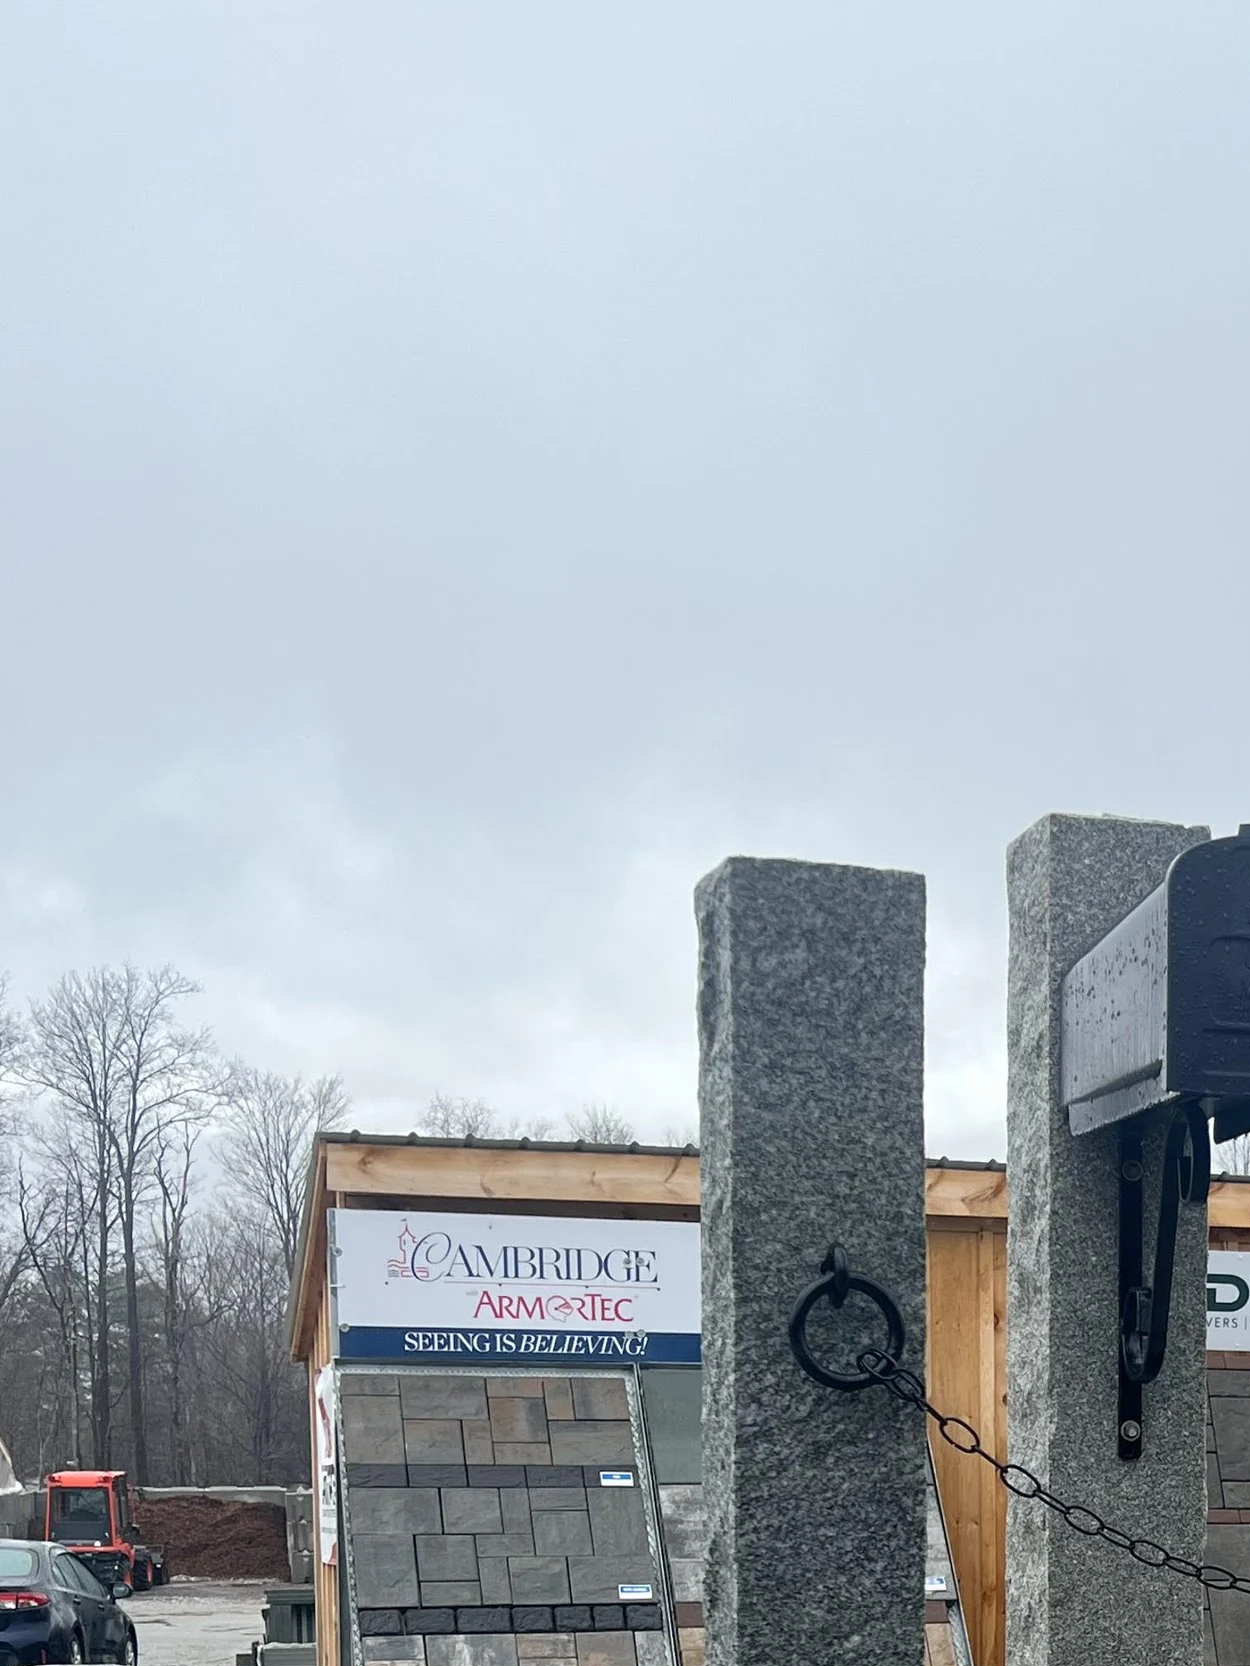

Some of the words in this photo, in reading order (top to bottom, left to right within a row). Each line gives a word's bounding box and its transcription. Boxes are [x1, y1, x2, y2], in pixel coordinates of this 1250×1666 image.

[411, 1231, 659, 1283] CAMBRIDGE
[1206, 1316, 1238, 1329] VERS
[404, 1331, 491, 1353] SEEING
[494, 1333, 517, 1353] IS
[518, 1334, 649, 1356] BELIEVING!
